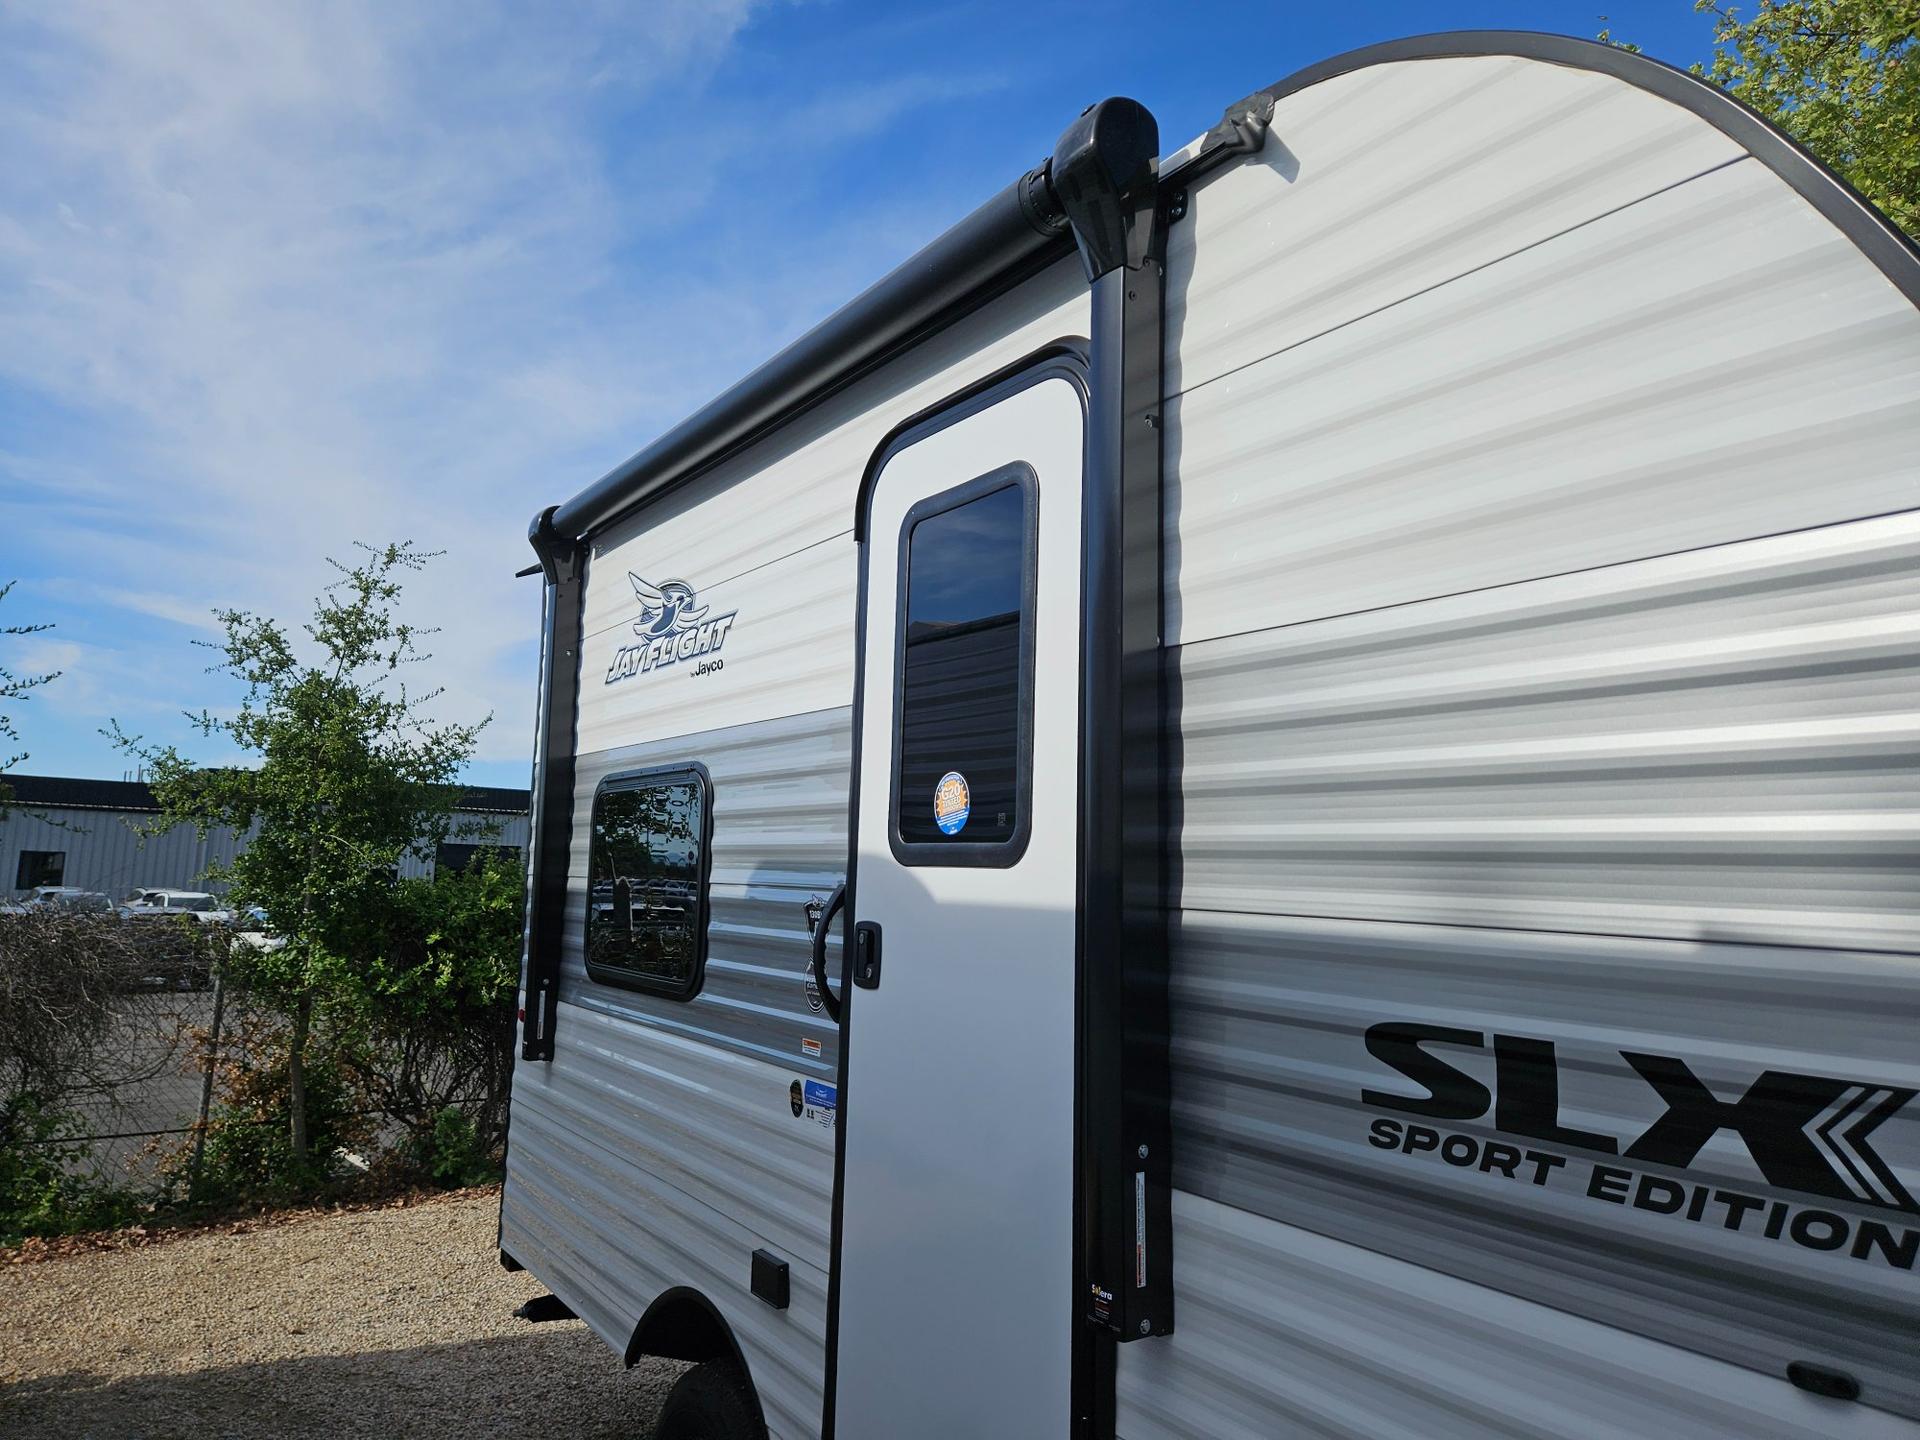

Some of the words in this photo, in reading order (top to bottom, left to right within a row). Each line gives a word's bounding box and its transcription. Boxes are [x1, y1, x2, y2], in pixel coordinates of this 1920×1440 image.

[695, 658, 723, 677] Jayco
[1362, 1021, 1920, 1215] SLX
[1368, 1119, 1566, 1186] SPORT
[1587, 1163, 1920, 1271] EDITION
